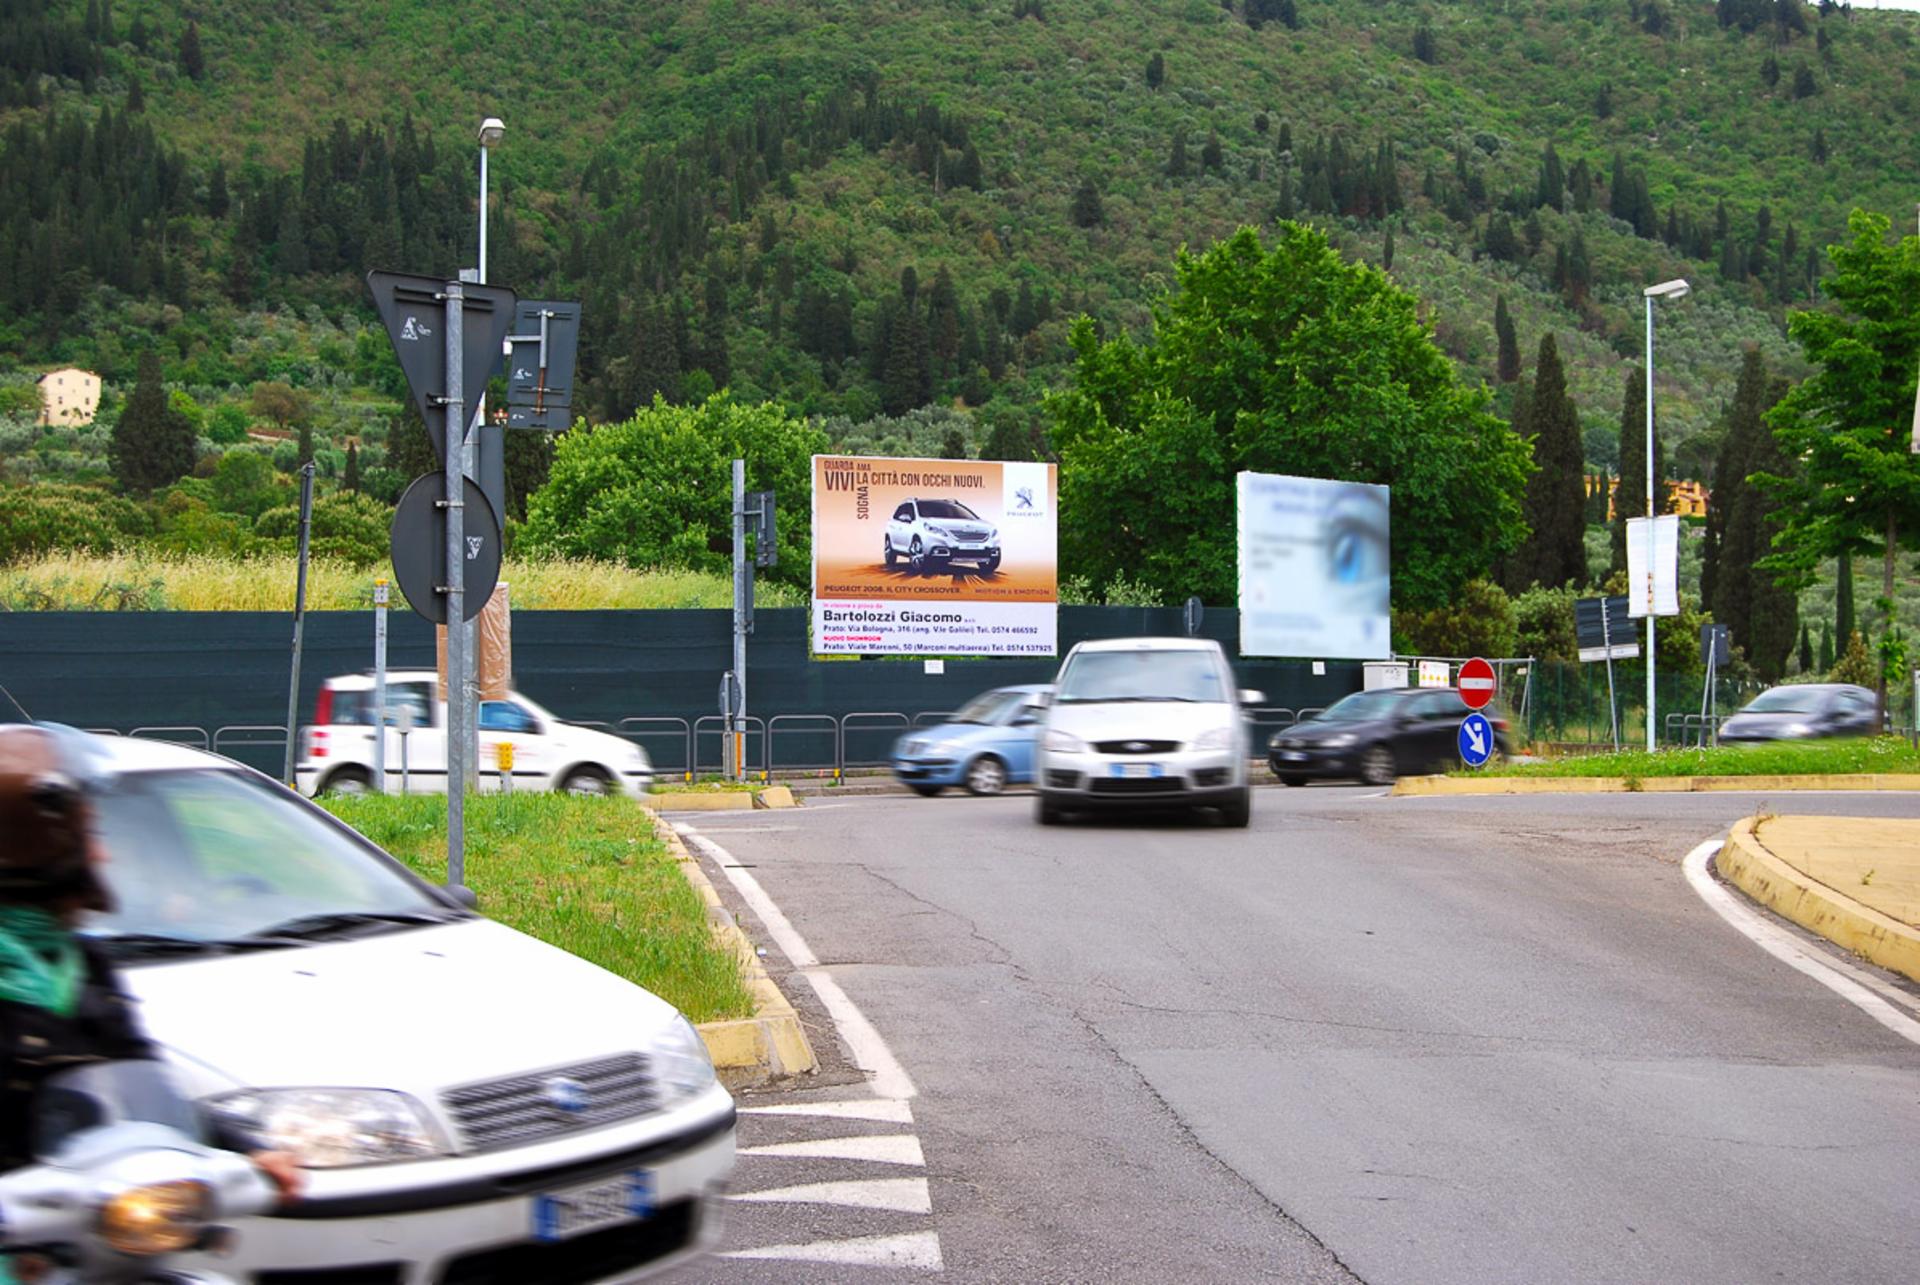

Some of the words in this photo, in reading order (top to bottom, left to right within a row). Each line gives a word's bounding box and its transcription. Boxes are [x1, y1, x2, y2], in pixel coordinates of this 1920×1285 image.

[824, 470, 855, 491] VIVI
[857, 472, 868, 485] LA
[871, 470, 899, 486] CITTÀ
[901, 473, 920, 487] CON
[922, 474, 951, 488] OCCHI
[857, 486, 869, 520] SOGNA
[823, 585, 861, 593] PEUGEOT
[823, 610, 896, 622] Bartolozzi
[900, 611, 962, 622] Giacomo
